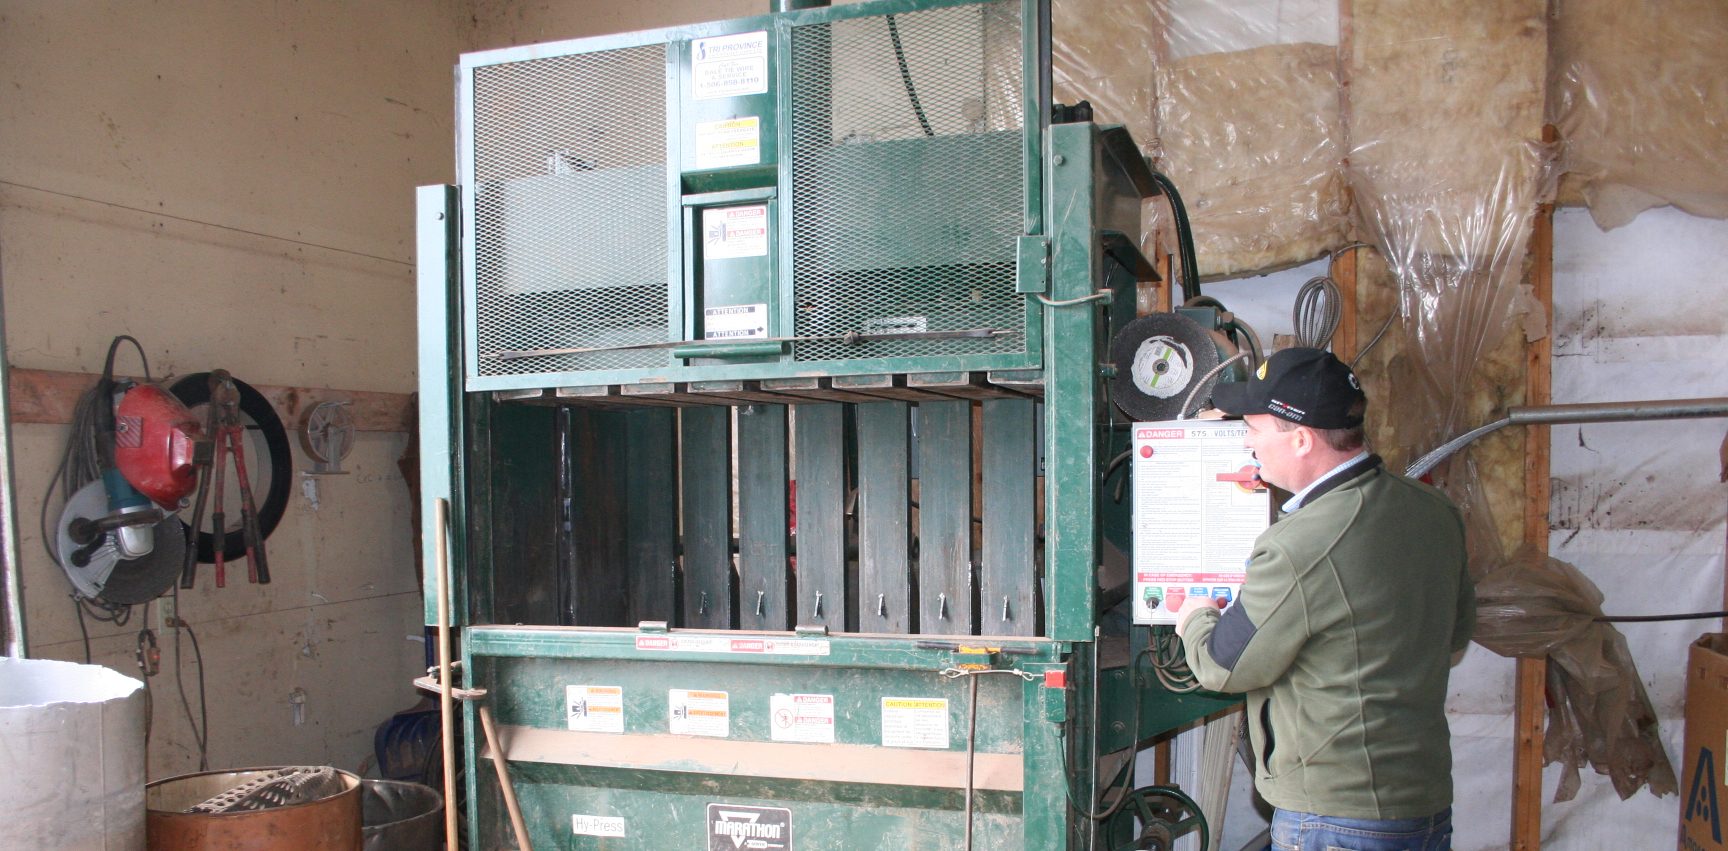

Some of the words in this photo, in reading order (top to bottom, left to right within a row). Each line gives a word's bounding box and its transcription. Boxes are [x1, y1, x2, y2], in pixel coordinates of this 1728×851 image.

[708, 45, 721, 54] TRI
[722, 41, 763, 51] PROVINCE
[736, 209, 761, 217] DANGER
[712, 306, 749, 315] ATTENTION
[712, 329, 749, 338] ATTENTION
[1268, 403, 1304, 421] can-am
[1145, 430, 1184, 438] DANGER
[1214, 429, 1248, 437] VOLTS/TE
[645, 639, 668, 647] DANGER
[739, 641, 763, 649] DANGER
[802, 696, 829, 704] DANGER
[576, 817, 624, 833] Hy-Press
[715, 820, 781, 839] MARATHON
